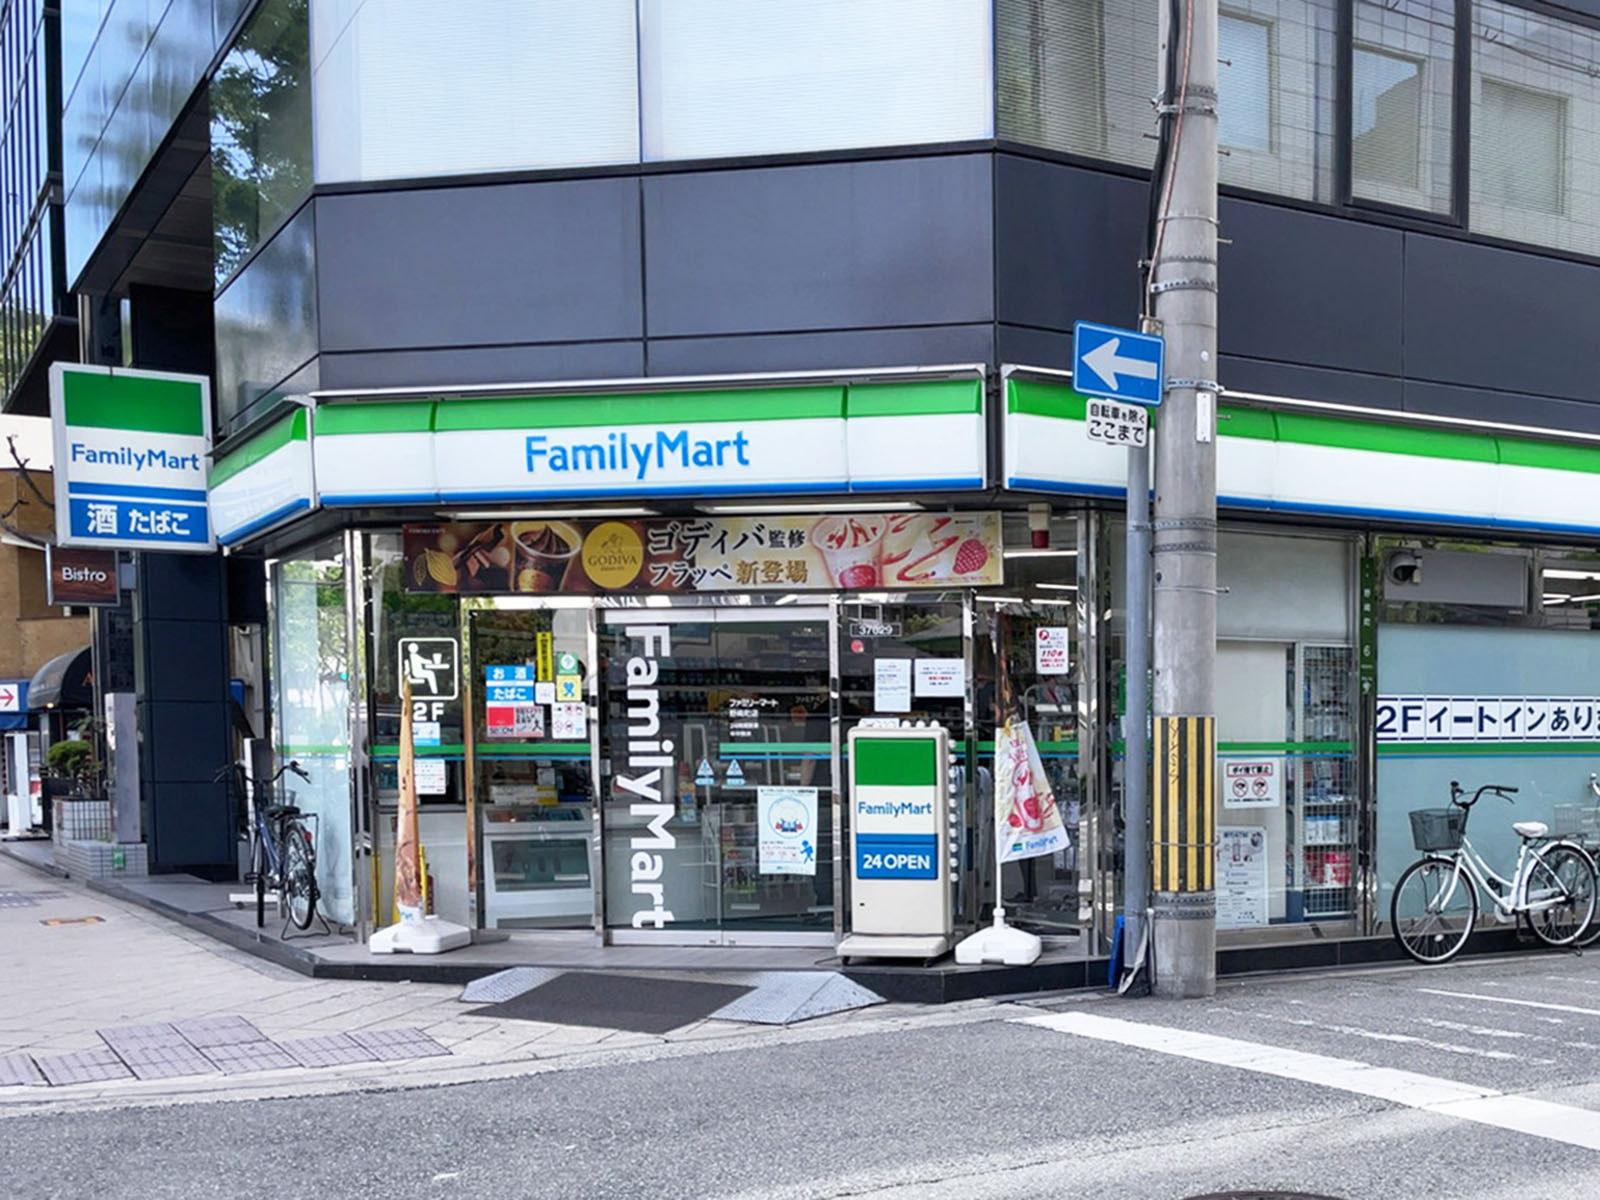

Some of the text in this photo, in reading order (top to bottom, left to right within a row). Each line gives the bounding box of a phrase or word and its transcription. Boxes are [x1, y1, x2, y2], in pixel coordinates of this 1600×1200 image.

[1089, 403, 1145, 425] 自転車を除く
[1089, 419, 1145, 444] ここまで
[71, 443, 200, 471] FamilyMart
[526, 430, 749, 480] FamilyMart
[87, 503, 190, 536] 酒 たばこ
[649, 521, 806, 558] ゴディバ監修
[588, 555, 638, 566] GODIVA
[62, 567, 107, 582] Bistro
[650, 559, 809, 587] フラッペ新登場
[493, 667, 527, 680] お酒
[494, 687, 527, 700] たばこ
[729, 698, 780, 708] ファミリーマート
[412, 702, 445, 721] 2F
[616, 626, 677, 928] FamilyMart
[858, 801, 933, 818] FamilyMart
